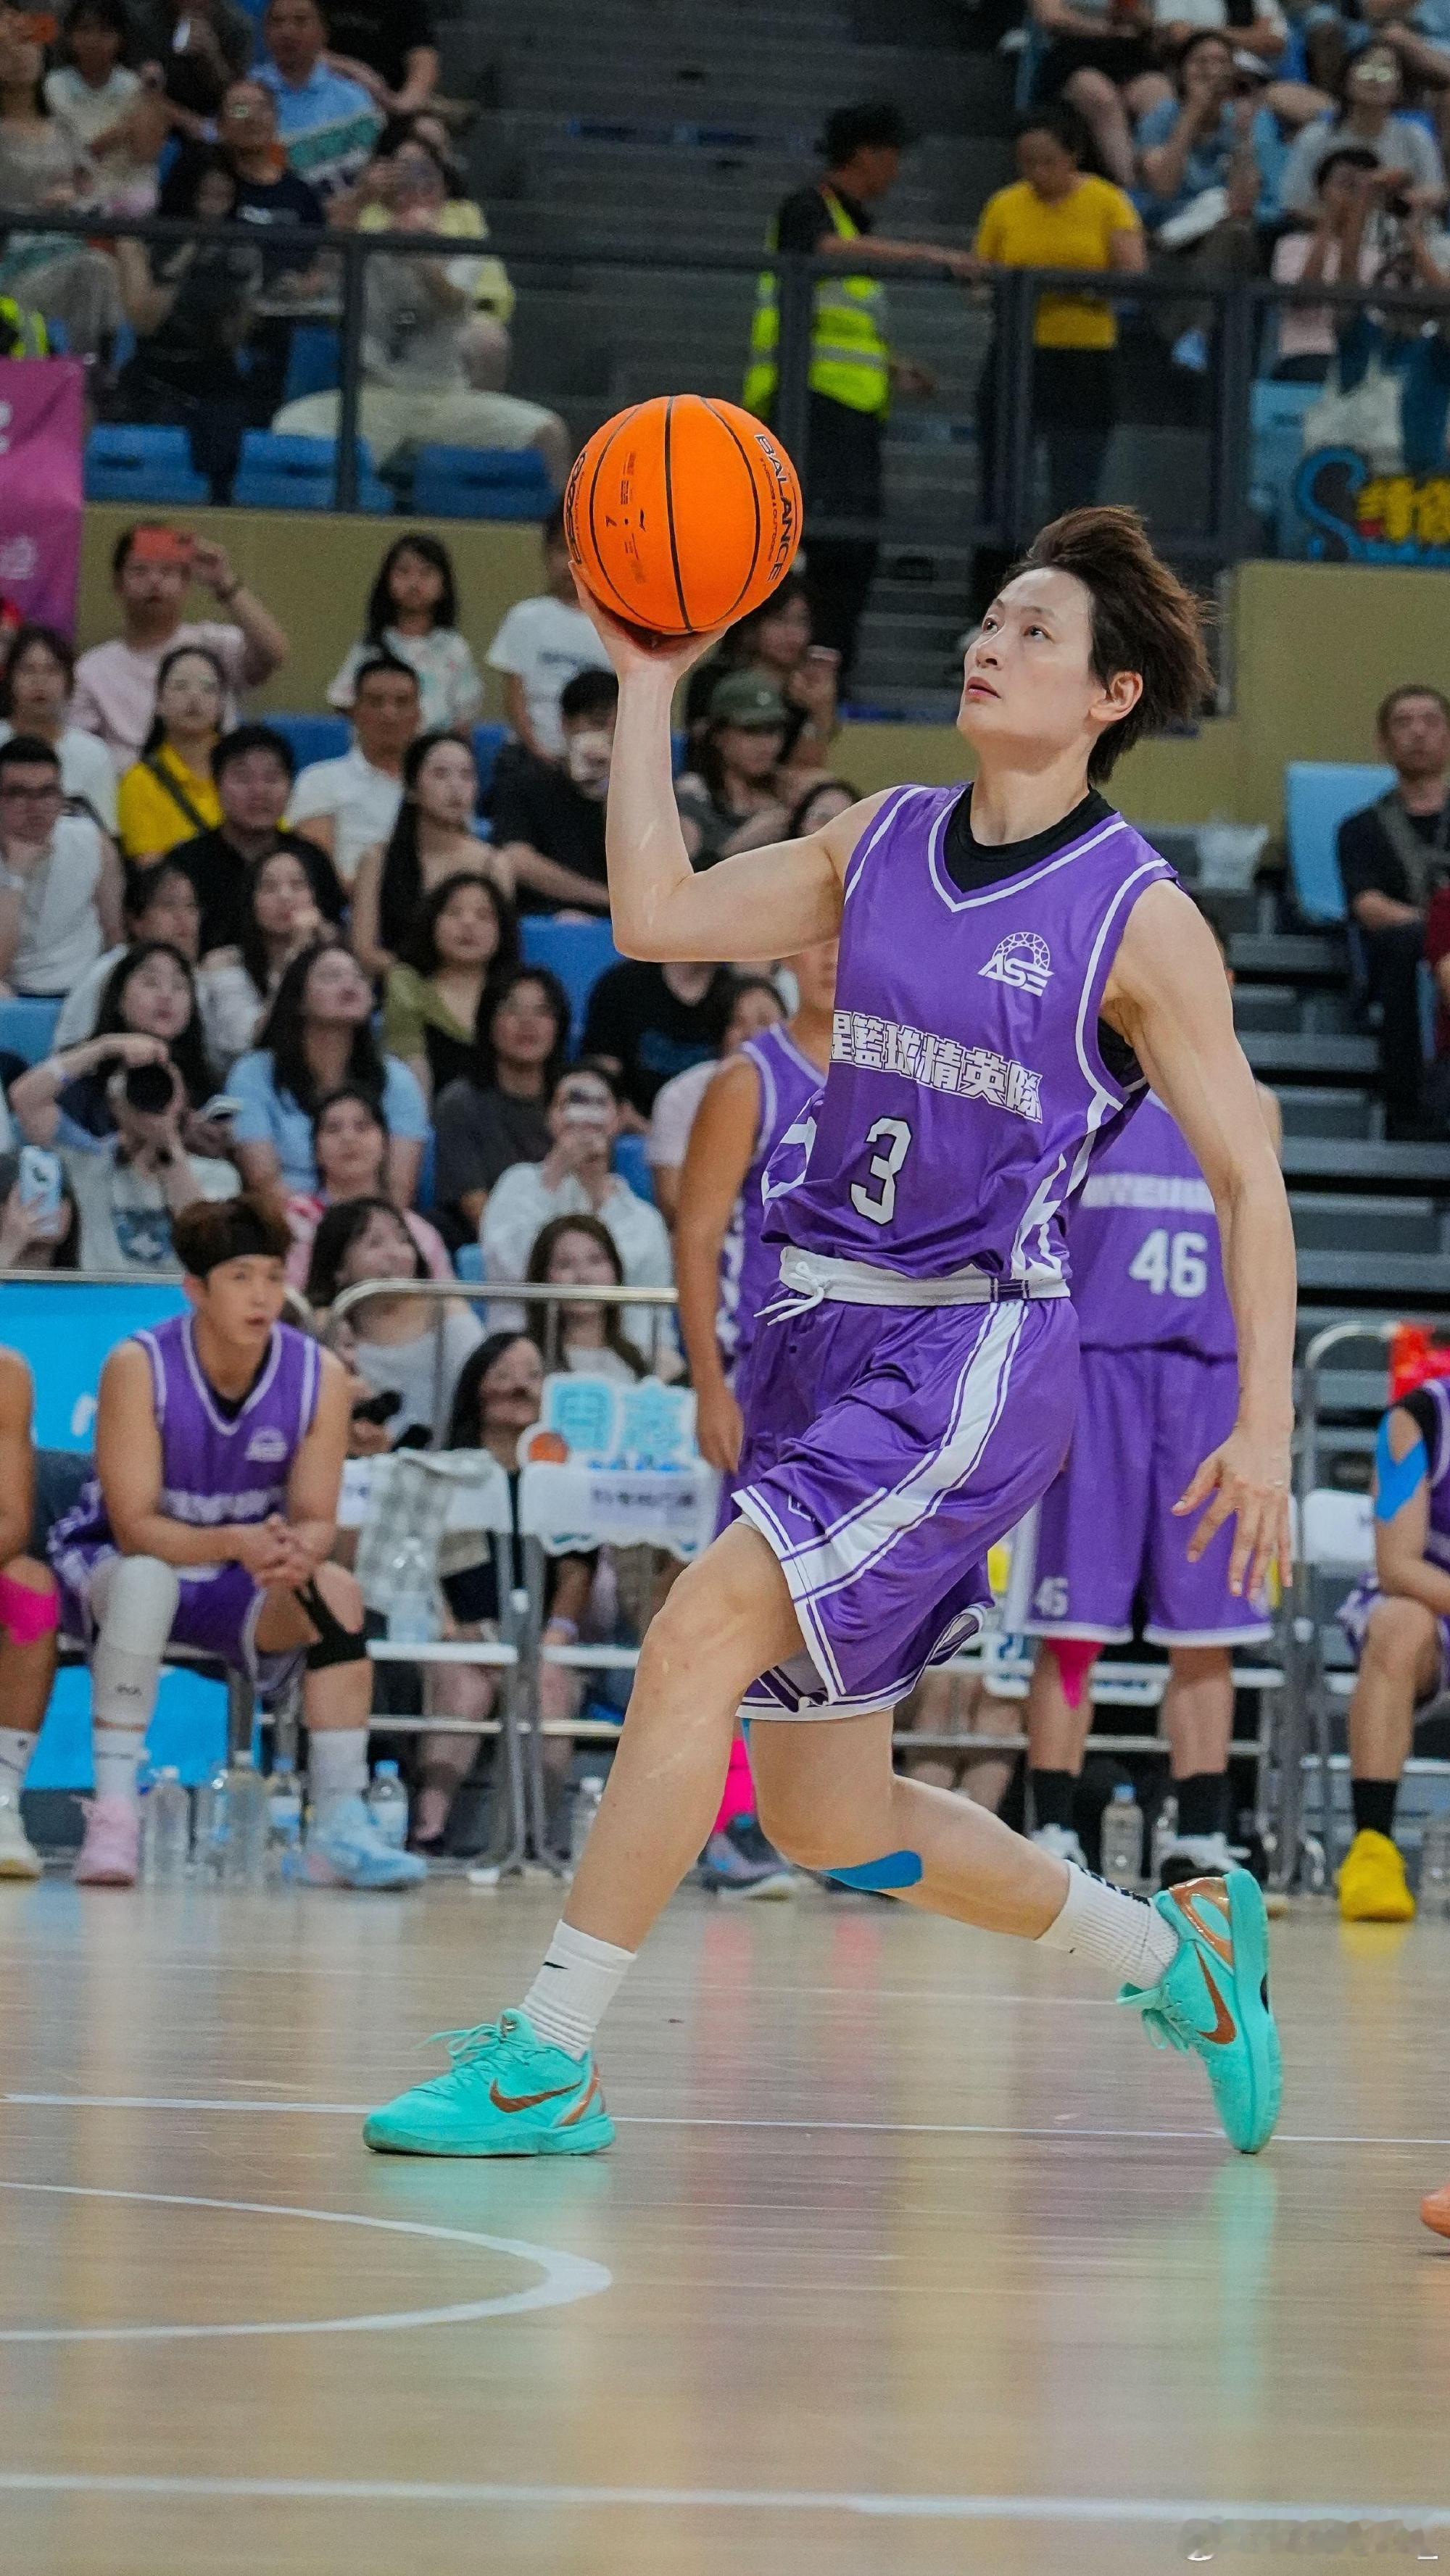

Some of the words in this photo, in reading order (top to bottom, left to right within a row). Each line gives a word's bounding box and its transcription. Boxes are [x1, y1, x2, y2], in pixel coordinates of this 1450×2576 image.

[754, 434, 792, 581] BALANCE
[977, 953, 1055, 997] ASE
[850, 1115, 913, 1226] 3
[1129, 1228, 1209, 1298] 46
